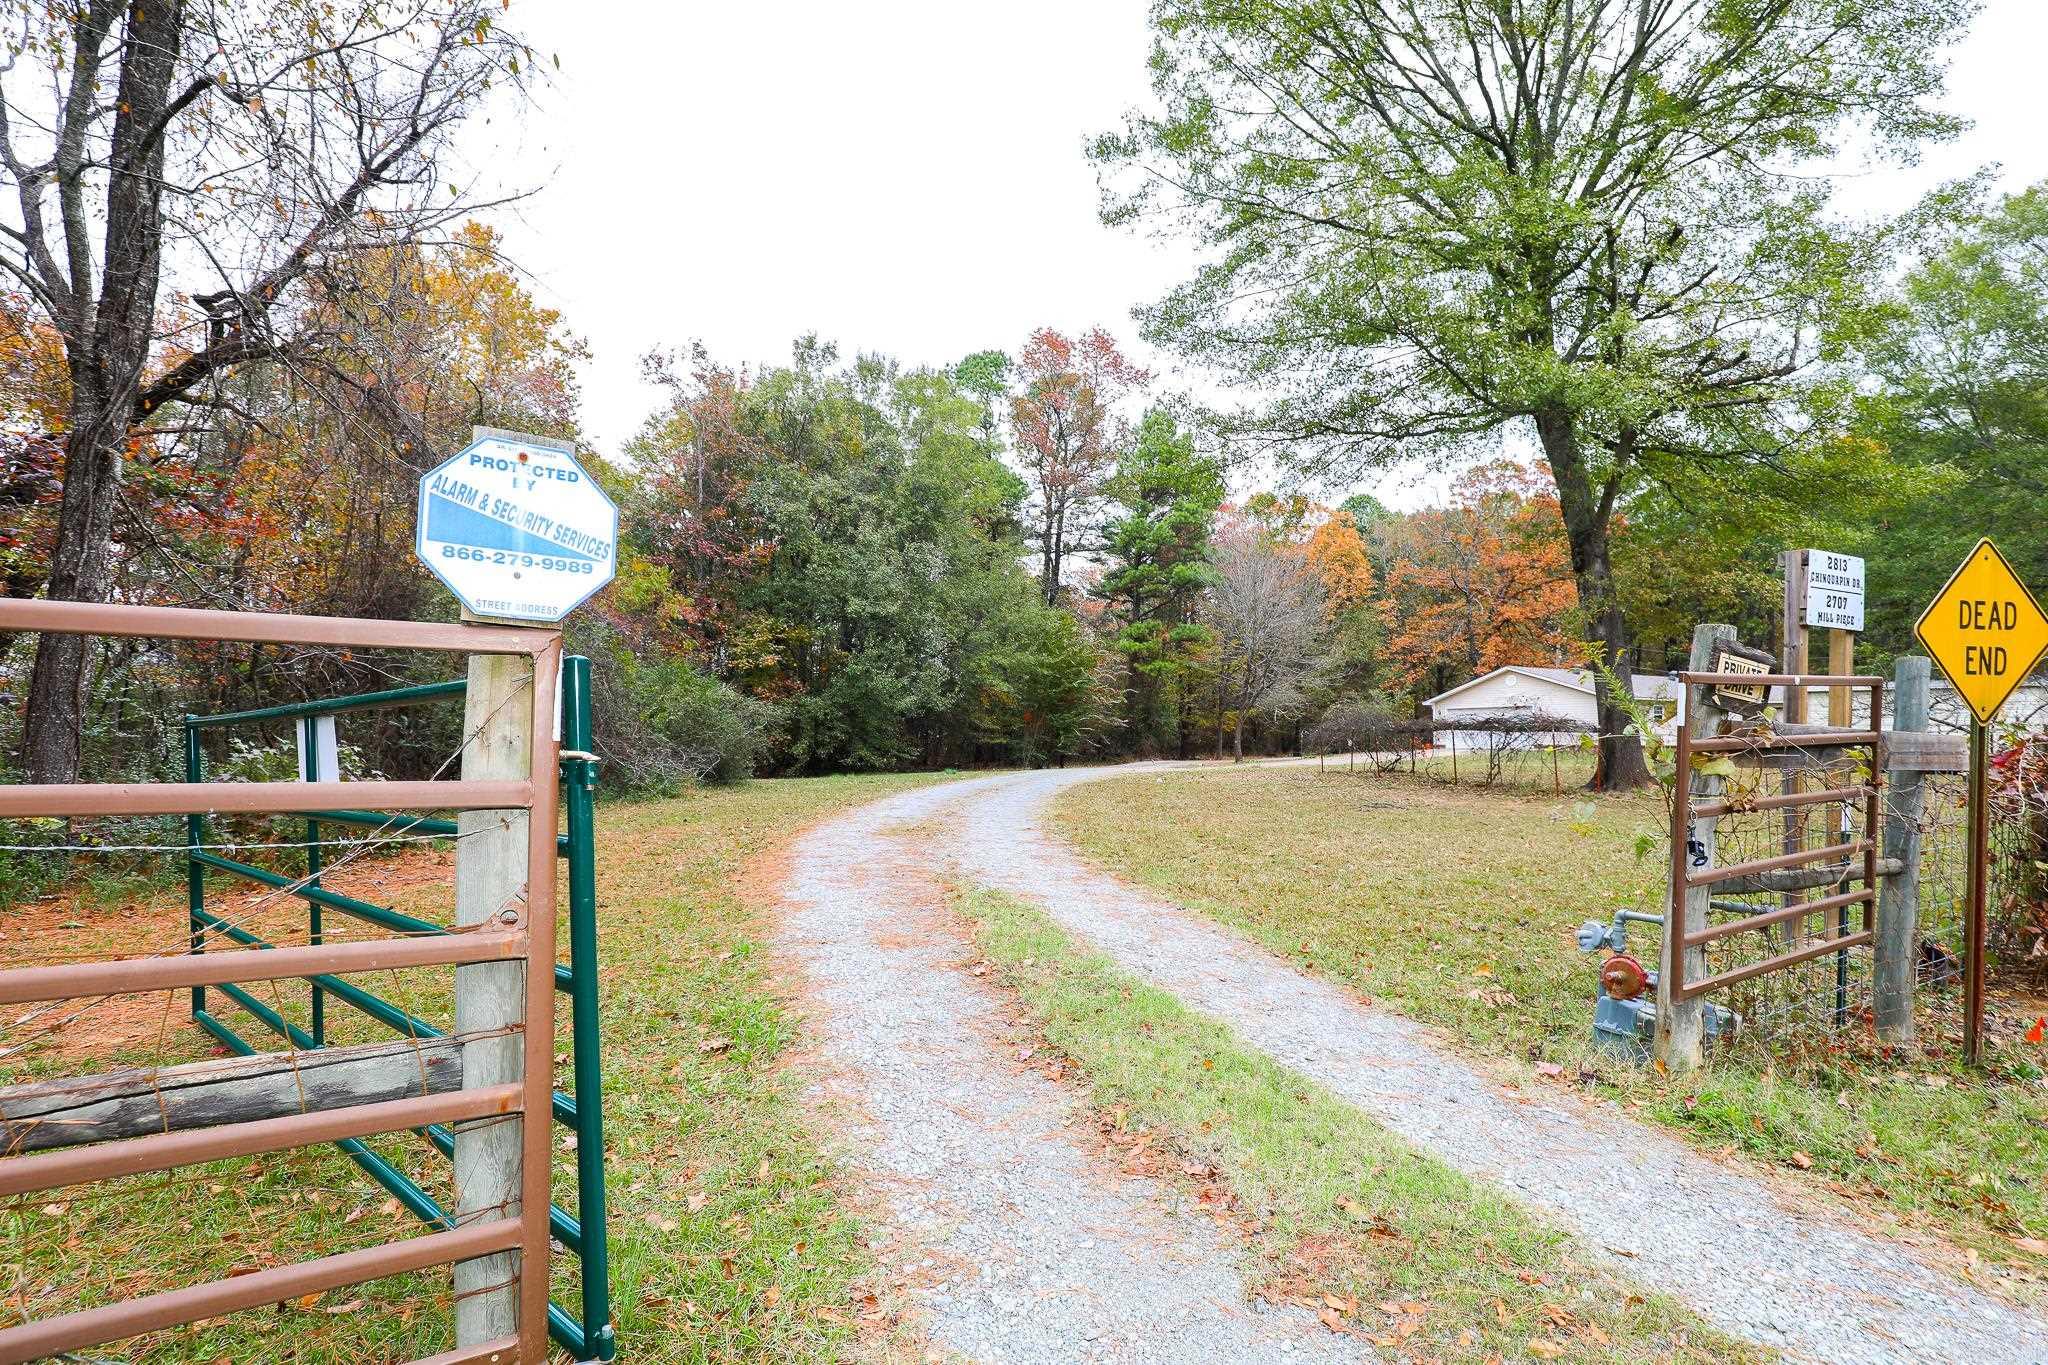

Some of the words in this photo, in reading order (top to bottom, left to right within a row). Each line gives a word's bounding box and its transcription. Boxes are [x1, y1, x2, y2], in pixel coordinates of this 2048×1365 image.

[430, 473, 479, 506] ALARM
[478, 493, 489, 511] &
[491, 498, 554, 537] SECURITY
[553, 523, 611, 560] SERVICES
[442, 545, 594, 574] 866-279-9989
[1827, 555, 1848, 572] 2813
[475, 598, 512, 611] STREET
[1826, 594, 1848, 610] 2707
[1817, 611, 1834, 623] MILL
[1836, 613, 1855, 626] PIECE
[1959, 599, 2017, 631] DEAD
[1965, 645, 2007, 676] END
